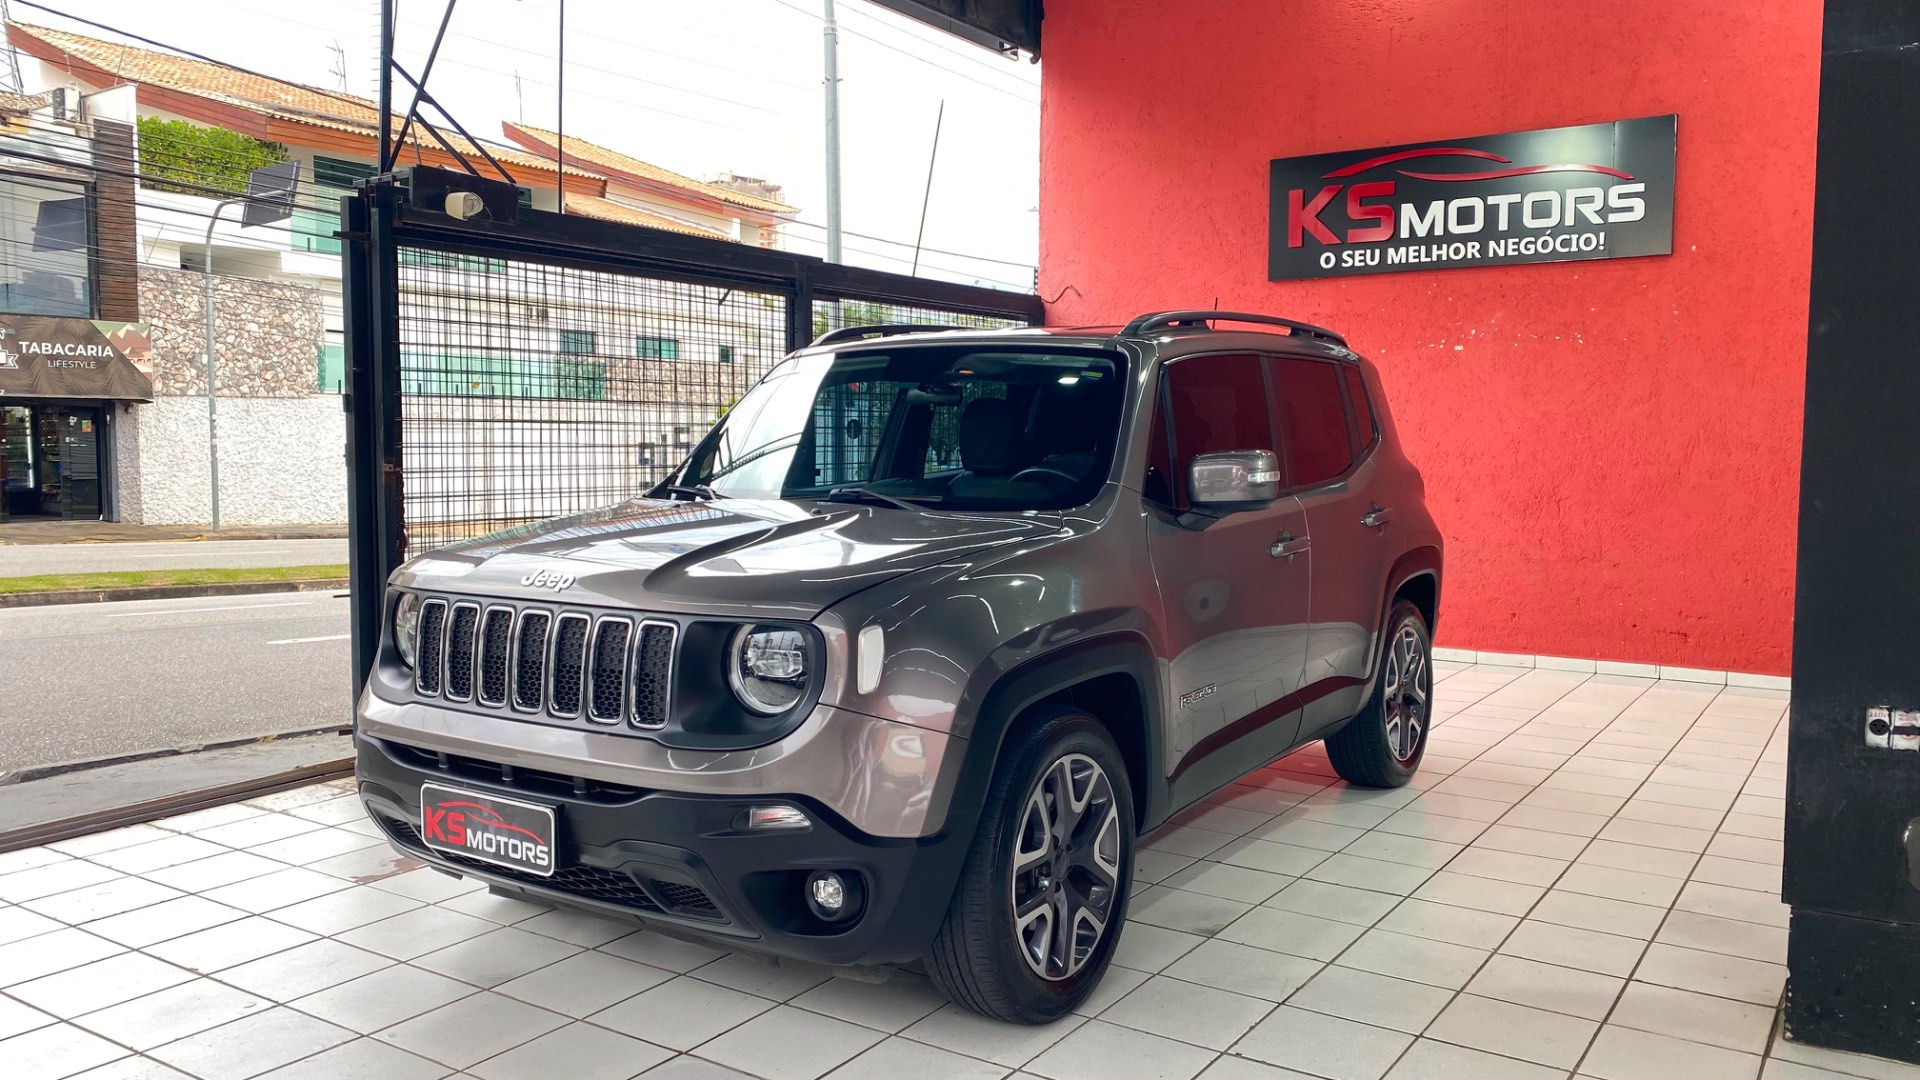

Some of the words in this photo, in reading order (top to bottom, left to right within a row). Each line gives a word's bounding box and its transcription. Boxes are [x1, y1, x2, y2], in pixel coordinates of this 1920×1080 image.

[1288, 181, 1395, 247] KS
[1400, 183, 1645, 238] MOTORS
[1320, 252, 1336, 269] O
[1341, 248, 1380, 267] SEU
[1387, 241, 1481, 265] MELHOR
[1488, 229, 1606, 257] NEGÓCIO!
[19, 341, 114, 358] TABACARIA
[48, 360, 97, 369] LIFESTYLE
[520, 568, 575, 593] Jeep
[425, 806, 465, 846] KS
[466, 829, 549, 866] MOTORS
